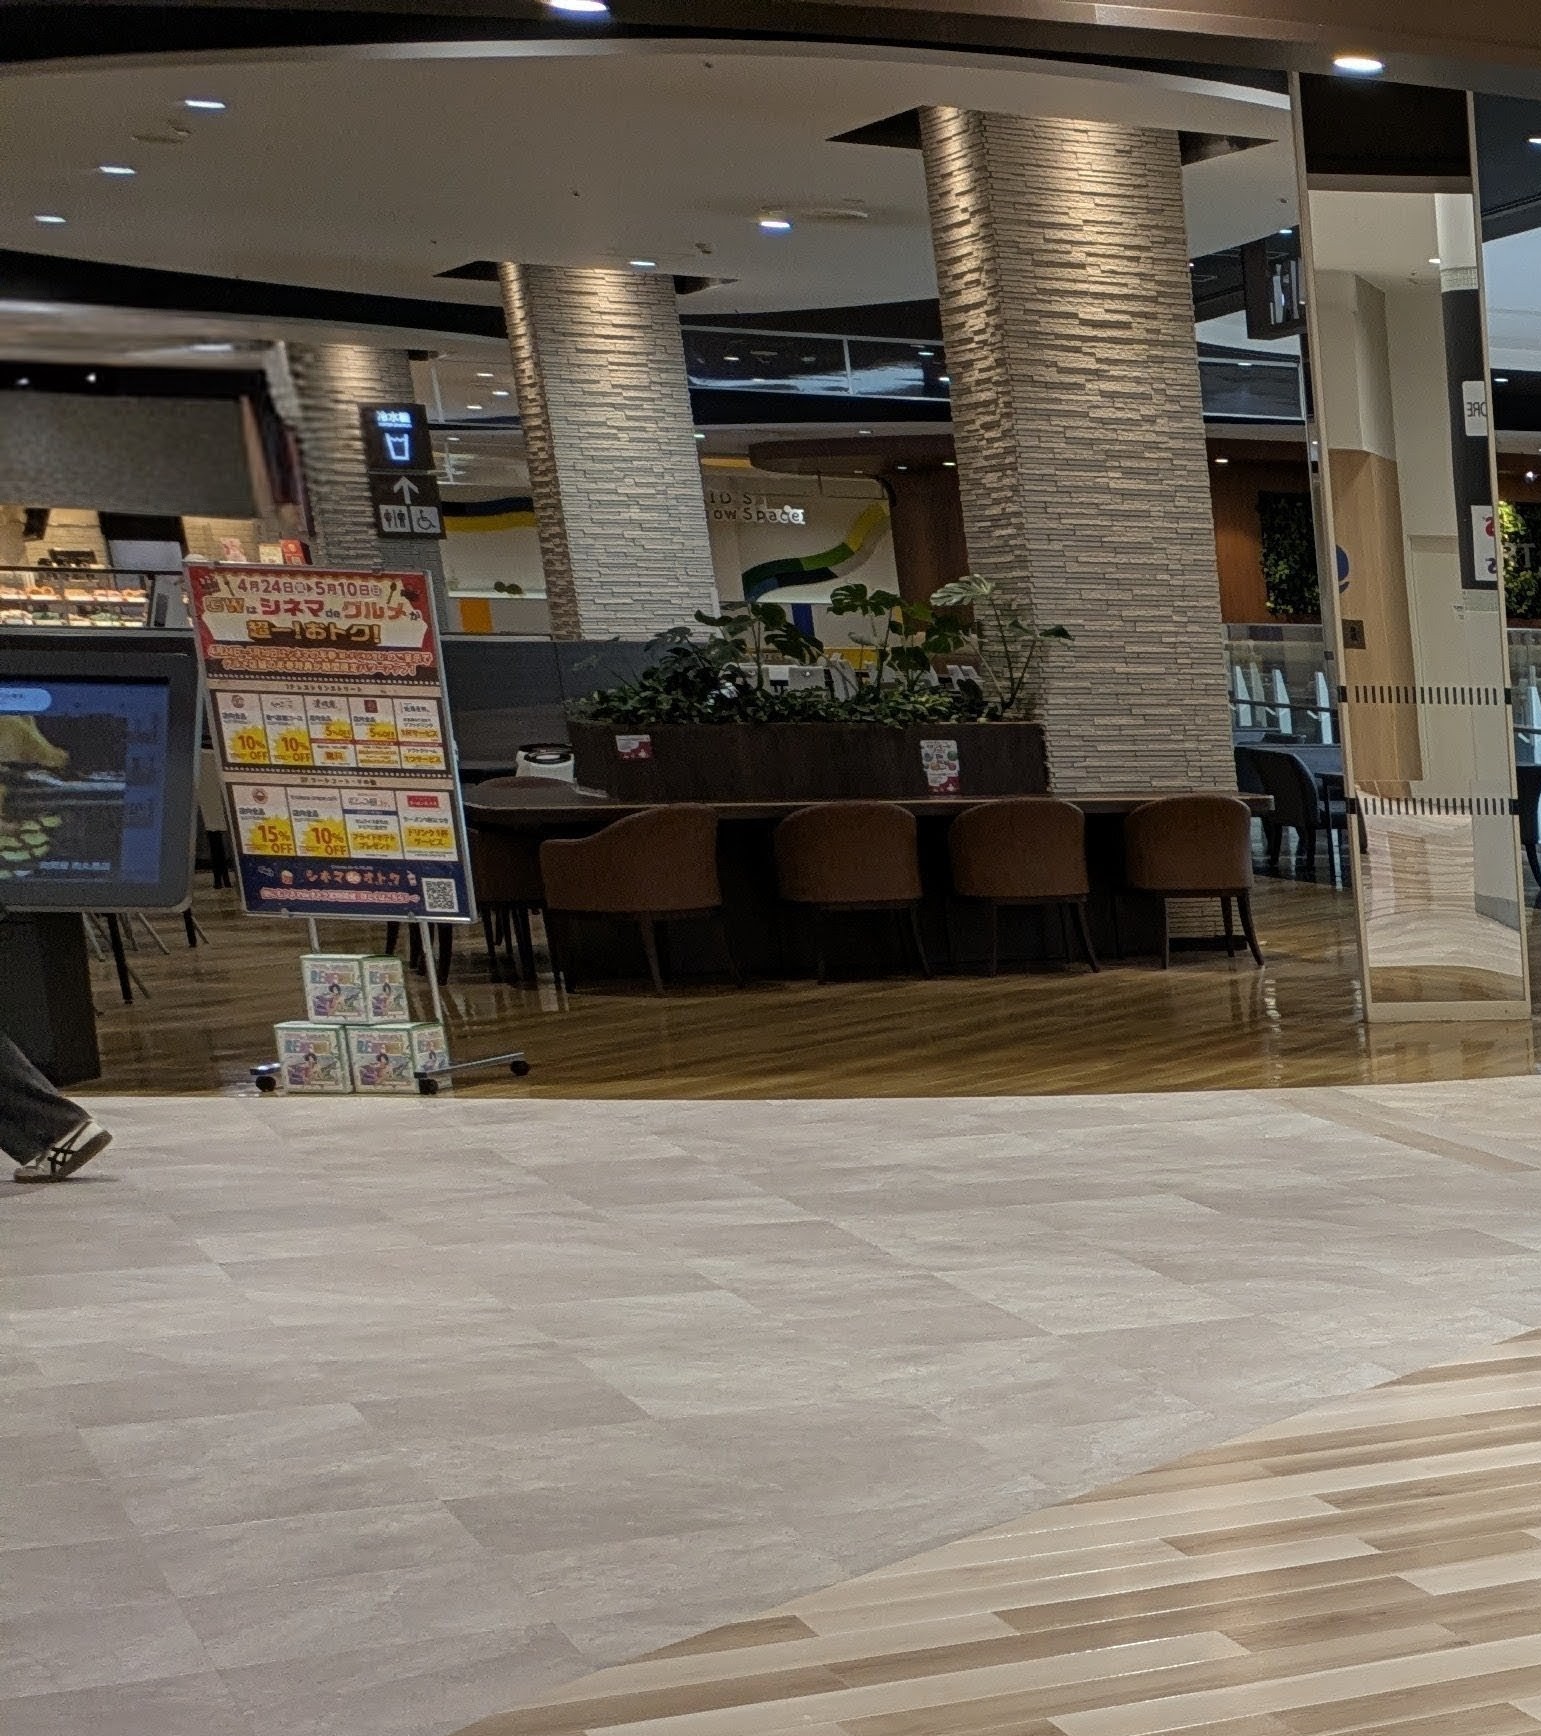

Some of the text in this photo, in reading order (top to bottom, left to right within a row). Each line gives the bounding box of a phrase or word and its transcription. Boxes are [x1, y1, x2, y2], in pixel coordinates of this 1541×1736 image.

[742, 507, 801, 522] Space
[249, 751, 268, 760] OFF
[292, 752, 311, 762] OFF
[257, 825, 291, 844] 15%
[311, 827, 344, 845] 10%
[271, 843, 293, 854] OFF
[325, 844, 346, 856] OFF
